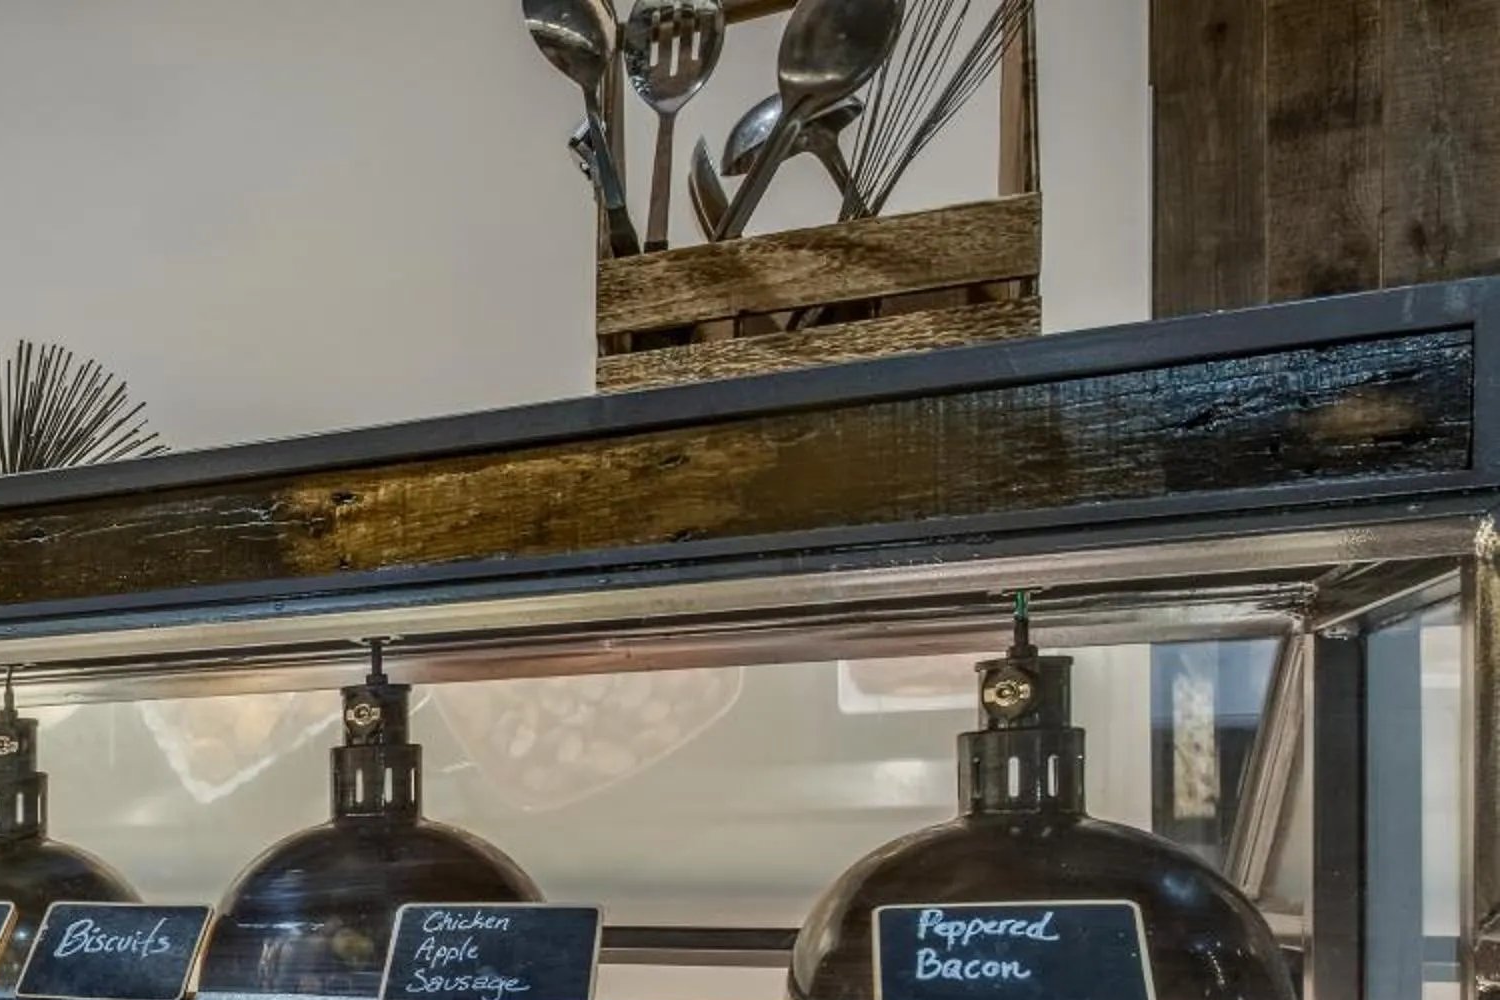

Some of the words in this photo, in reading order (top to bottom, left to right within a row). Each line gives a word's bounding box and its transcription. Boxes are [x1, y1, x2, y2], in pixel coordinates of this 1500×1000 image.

[422, 909, 511, 933] Chicken
[916, 909, 1061, 950] Peppered
[53, 917, 172, 959] Biscuits
[414, 936, 479, 969] Apple
[915, 948, 1032, 981] Bacon
